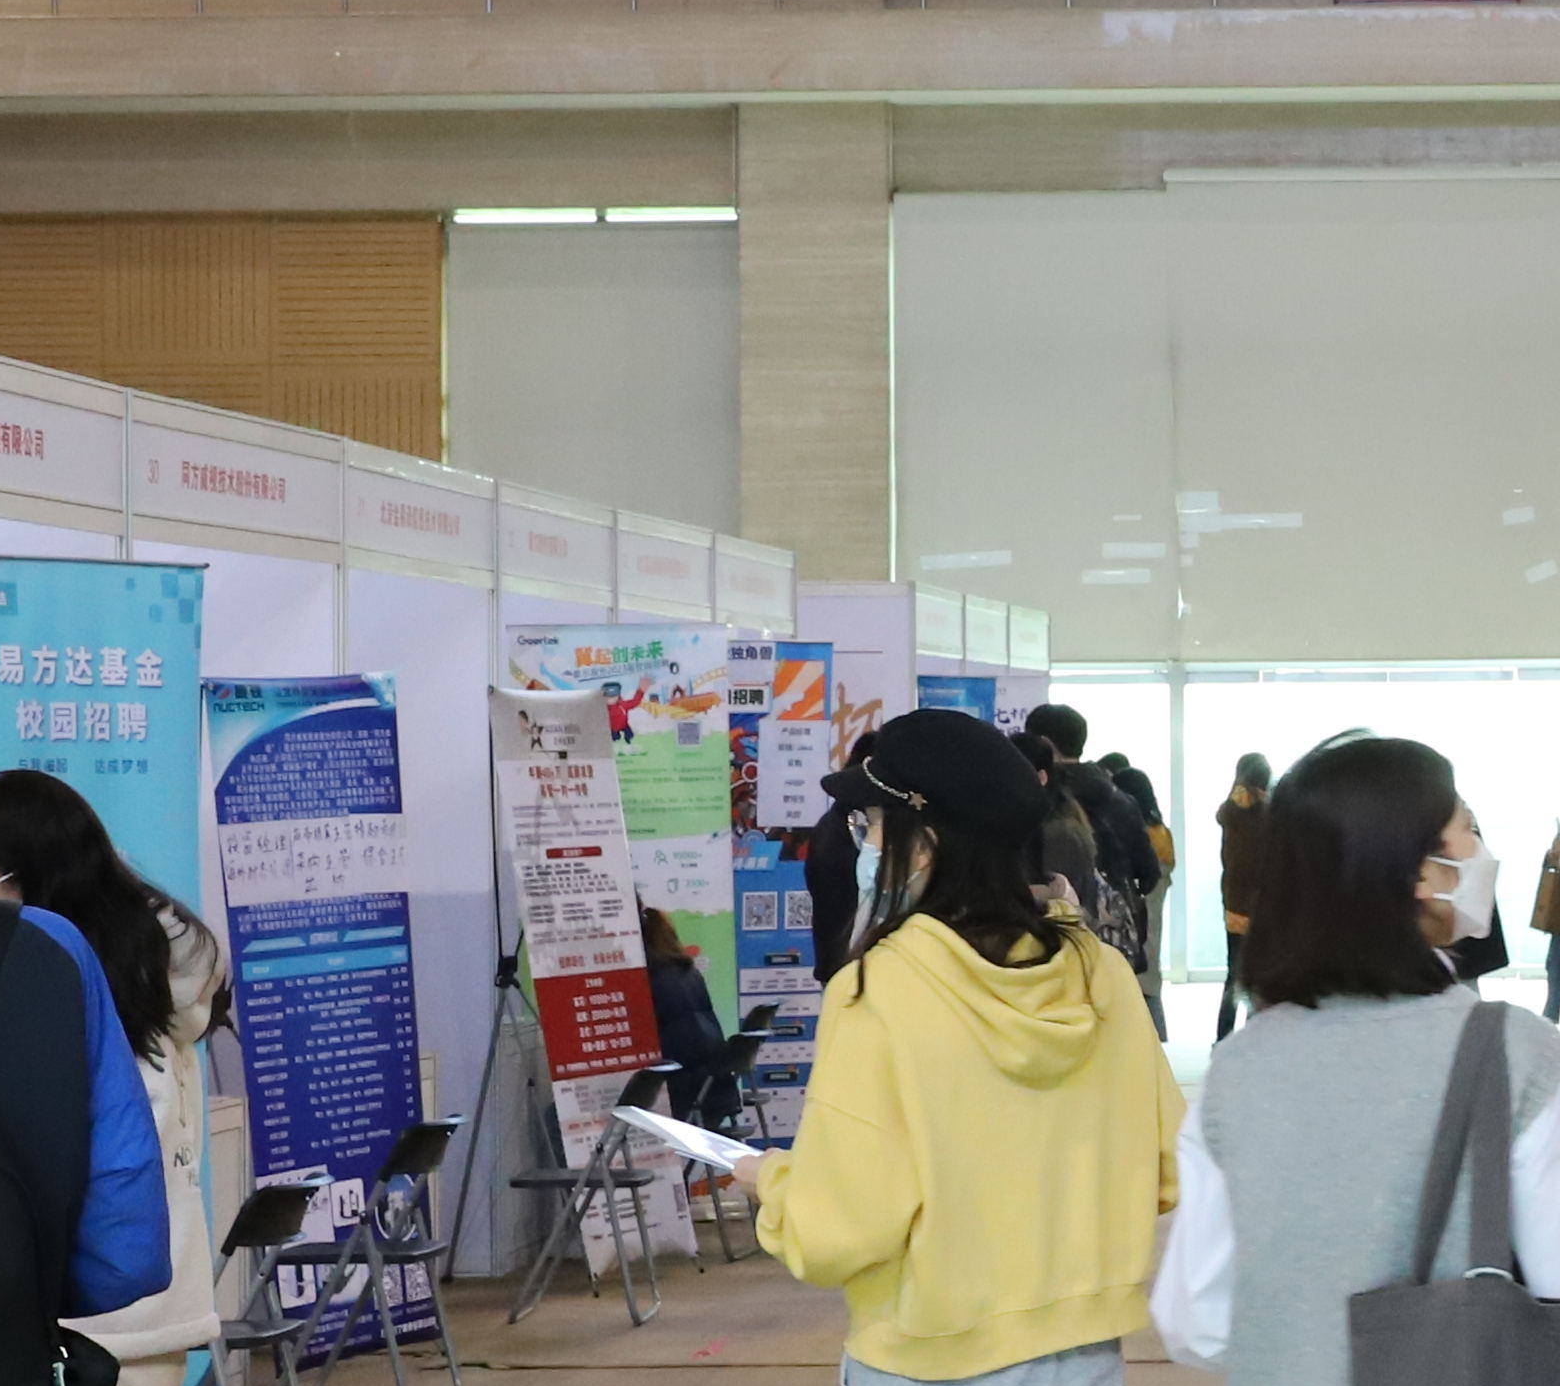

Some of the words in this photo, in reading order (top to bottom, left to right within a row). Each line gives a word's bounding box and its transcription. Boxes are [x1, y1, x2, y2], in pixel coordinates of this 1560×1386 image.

[516, 634, 560, 647] Goertek
[727, 645, 774, 661] 独角兽
[727, 688, 765, 706] 招聘
[14, 698, 149, 743] 校园招聘
